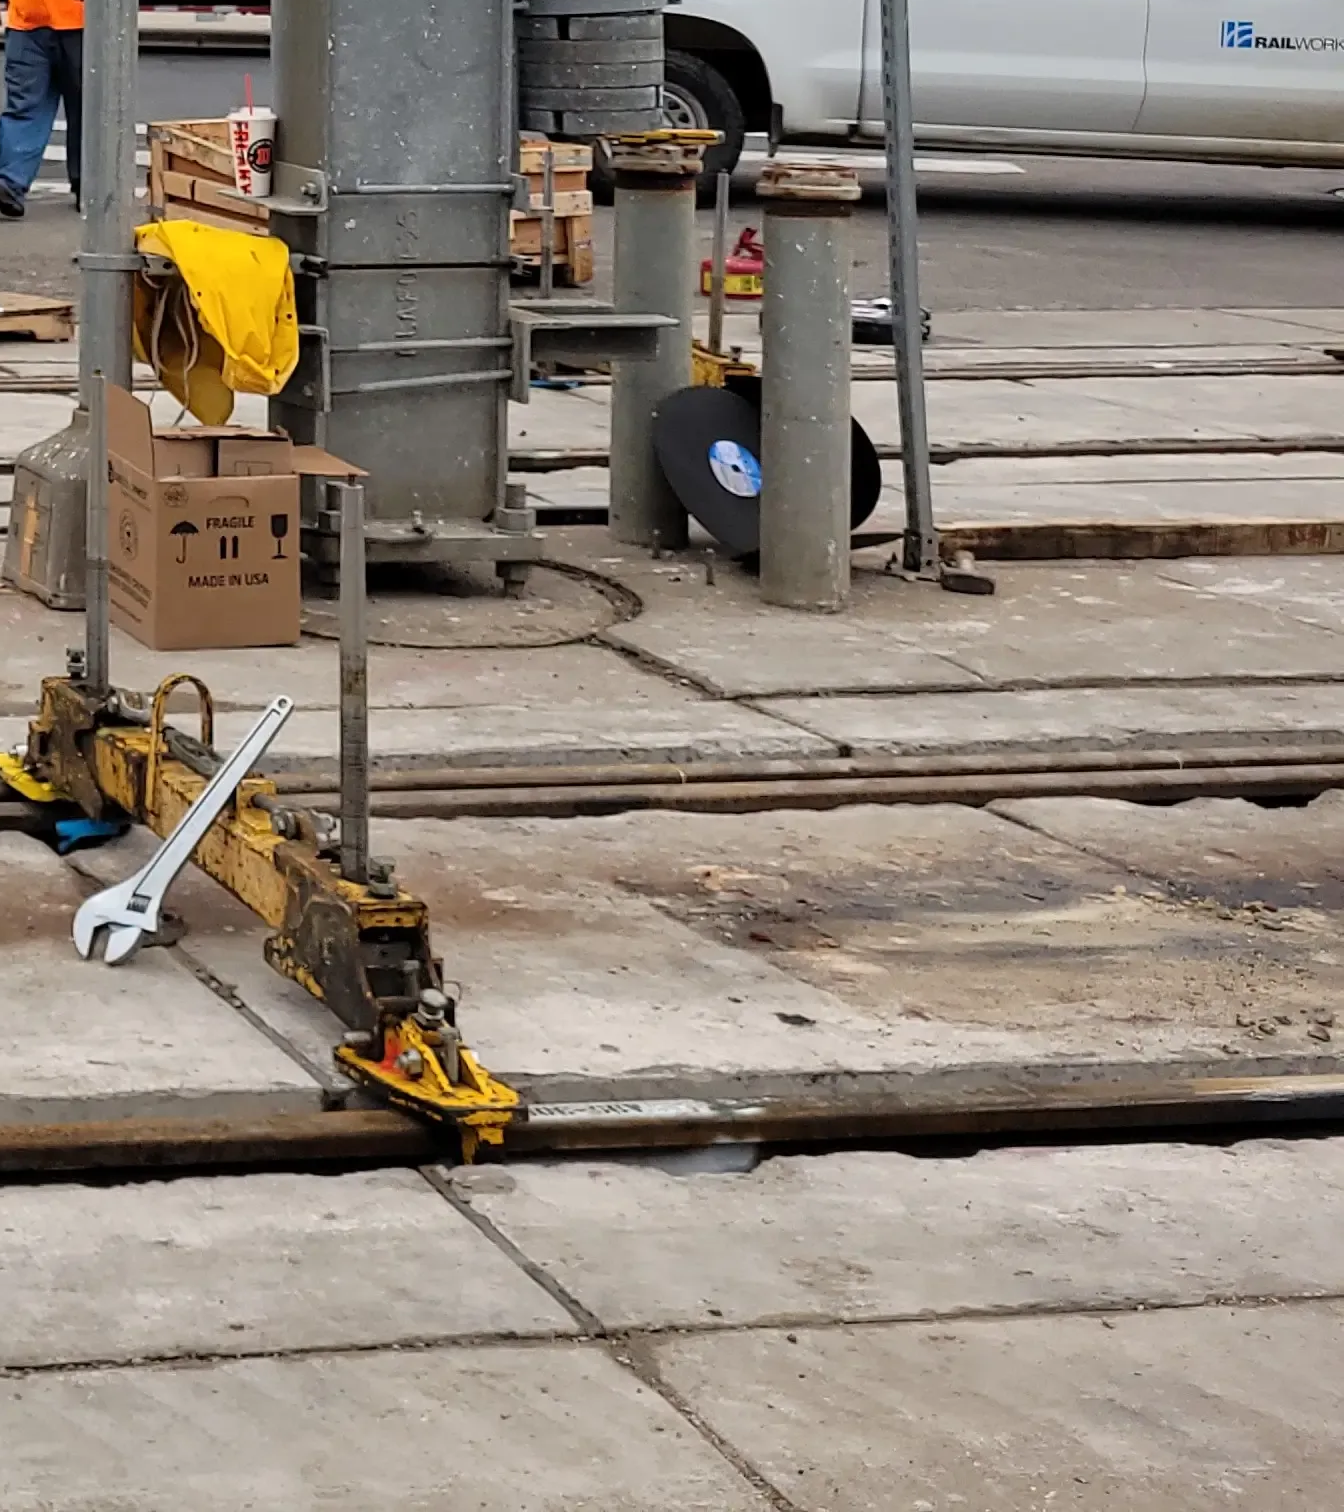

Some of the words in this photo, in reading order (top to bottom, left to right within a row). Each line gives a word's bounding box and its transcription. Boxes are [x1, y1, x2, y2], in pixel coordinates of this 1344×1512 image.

[206, 515, 256, 530] FRAGILE
[188, 574, 225, 587] MADE
[228, 574, 241, 586] IN
[244, 572, 269, 586] USA
